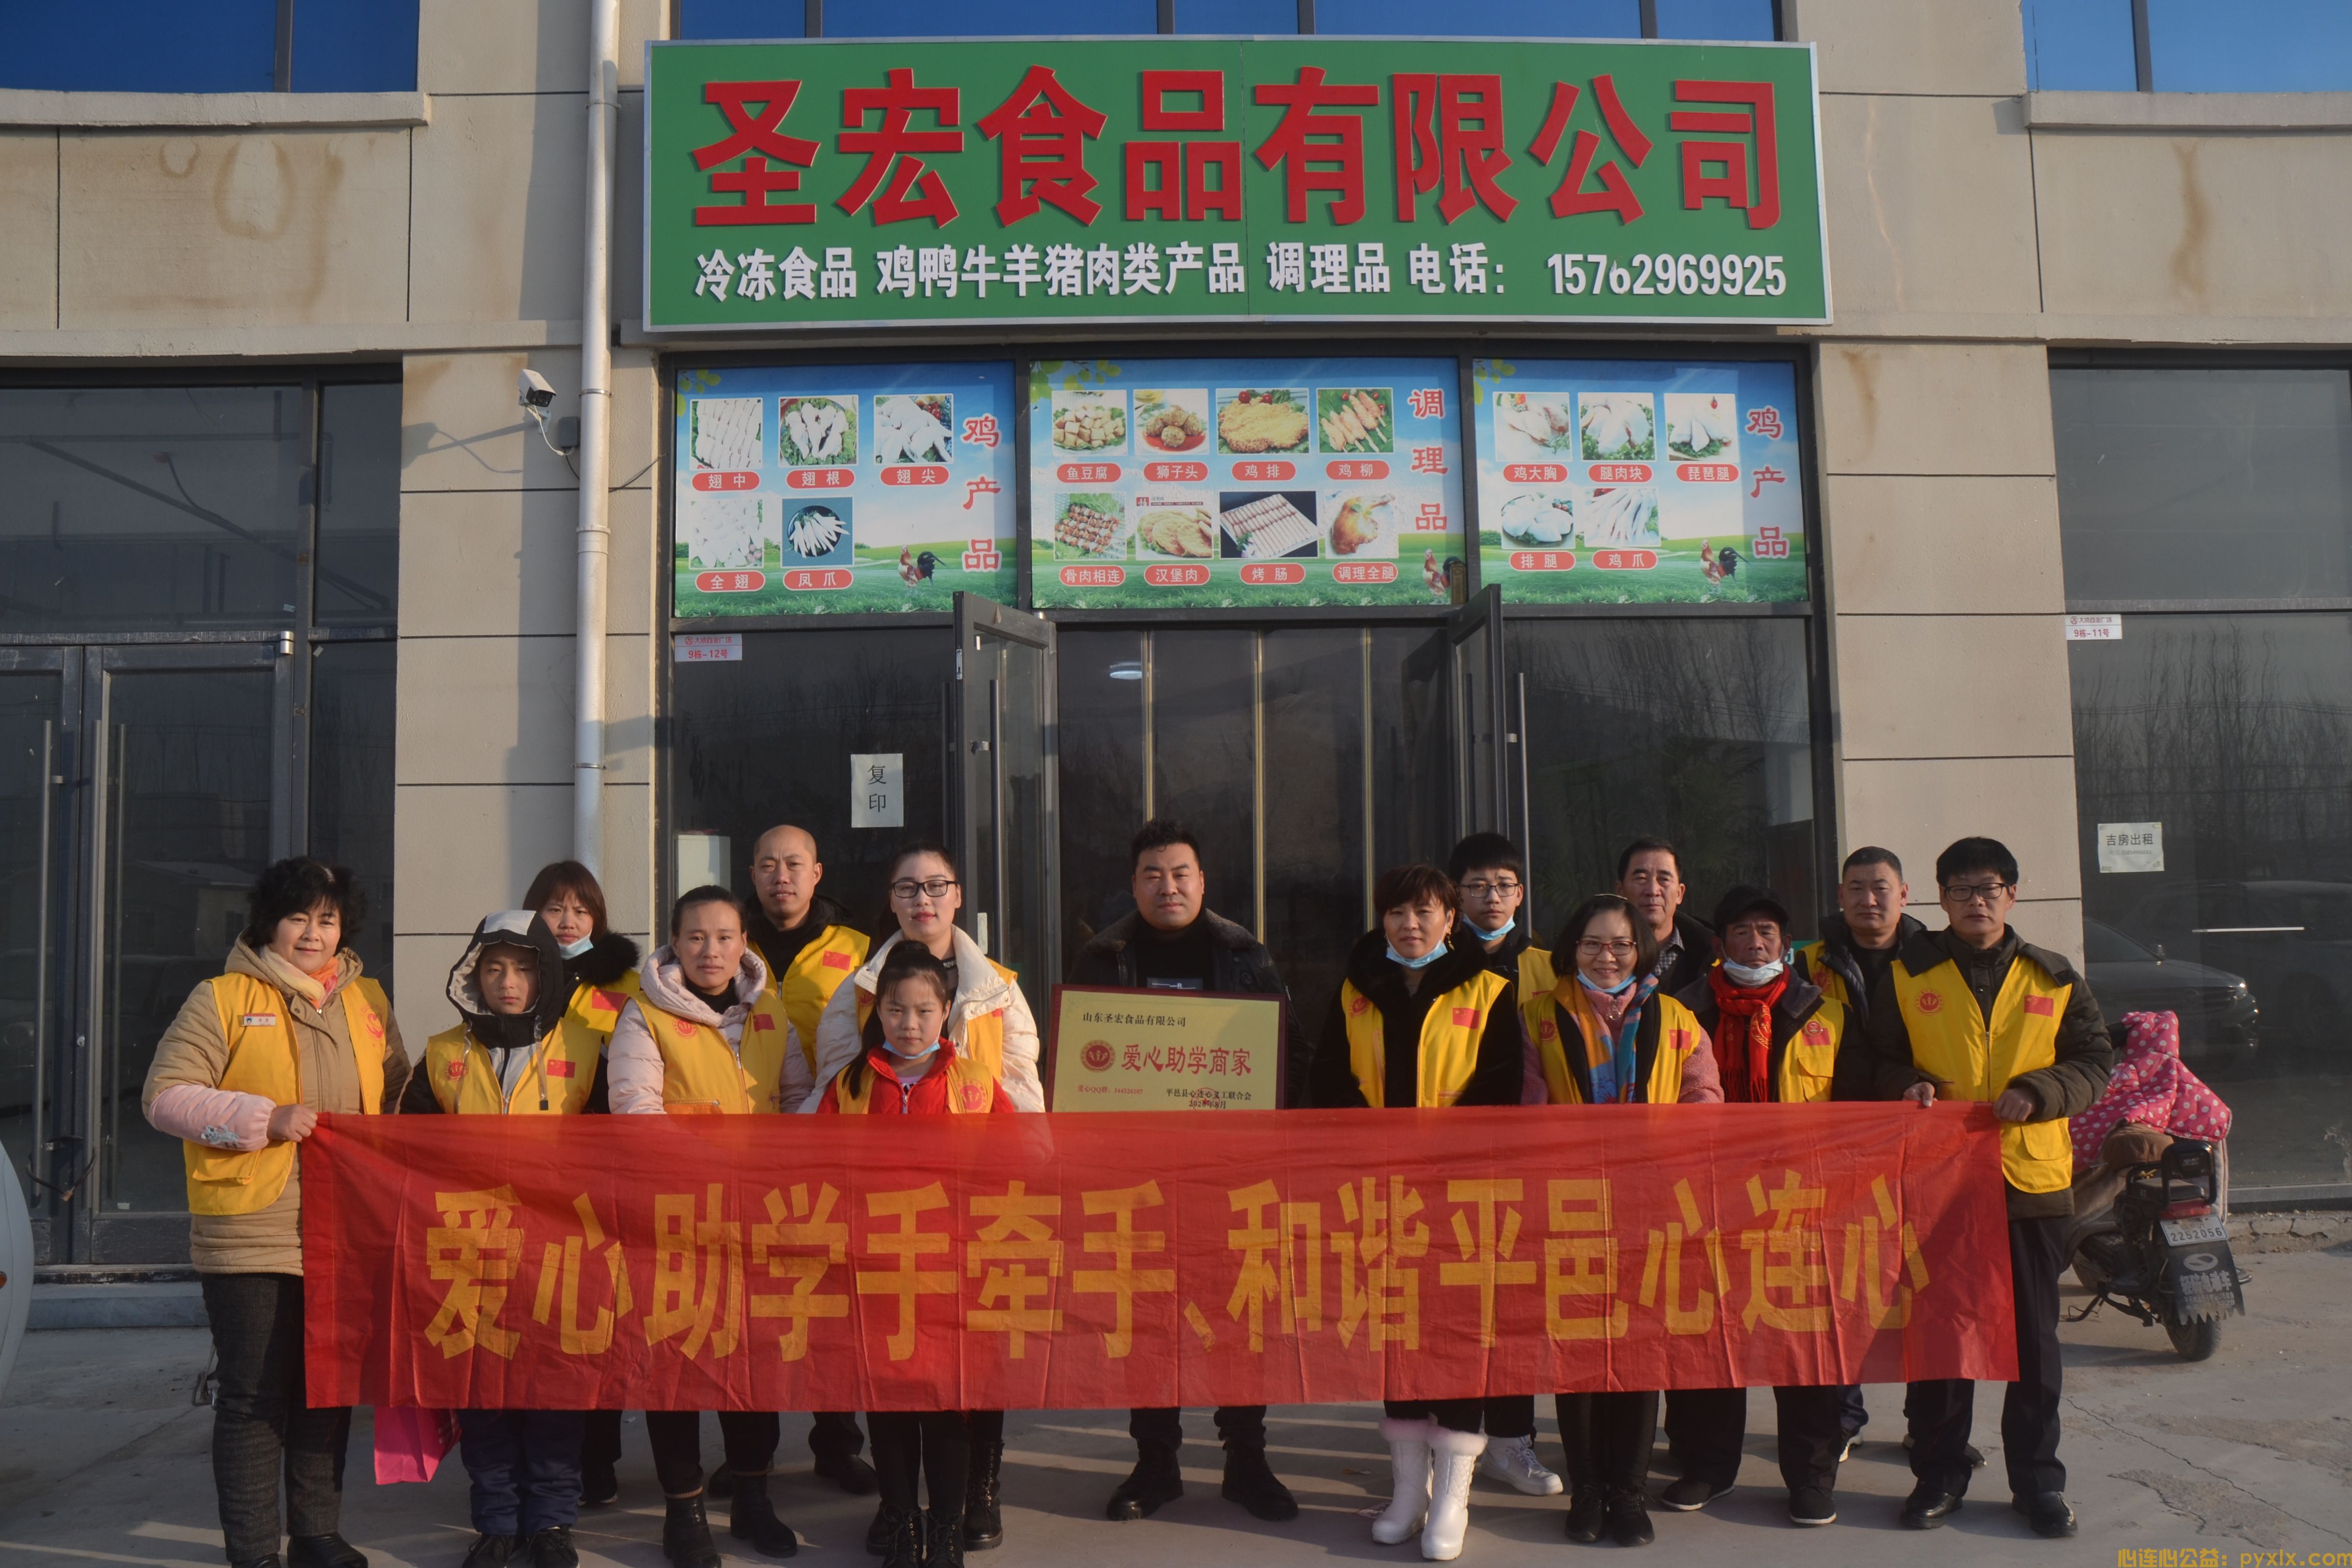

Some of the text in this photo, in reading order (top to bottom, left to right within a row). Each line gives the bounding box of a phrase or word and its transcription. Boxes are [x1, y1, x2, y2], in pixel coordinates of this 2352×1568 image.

[690, 64, 1780, 230] 圣宏食品有限公司
[694, 245, 857, 302] 冷冻食品
[876, 241, 1245, 298] 鸡鸭牛羊猪肉类产品
[1266, 241, 1390, 293] 调理品
[1547, 253, 1786, 296] 15762969925
[1406, 388, 1450, 532] 调理品
[896, 468, 936, 484] 翅尖
[1066, 464, 1107, 481] 鱼豆腐
[1156, 464, 1198, 480] 狮子头
[1244, 464, 1280, 479] 鸡排
[1338, 462, 1374, 477] 鸡柳
[1514, 465, 1557, 481] 鸡大胸
[1600, 465, 1643, 481] 腿肉块
[1687, 465, 1730, 481] 琵琶腿
[708, 474, 746, 489] 翅中
[801, 471, 840, 486] 翅根
[1746, 407, 1790, 557] 鸡产品
[961, 414, 1003, 572] 鸡产品
[1521, 553, 1558, 569] 排腿
[1608, 553, 1644, 568] 鸡爪
[798, 572, 836, 587] 凤爪
[1065, 568, 1120, 583] 骨肉相连
[1156, 567, 1197, 582] 汉堡肉
[1252, 567, 1287, 581] 烤肠
[1338, 566, 1394, 580] 调理全腿
[710, 575, 749, 590] 全翅
[2074, 629, 2109, 638] 9栋-11号
[688, 649, 728, 659] 9栋-12号
[868, 765, 887, 813] 复印
[2106, 834, 2153, 846] 吉房出租
[1083, 1012, 1186, 1027] 山东圣宏食品有限公司
[1121, 1044, 1252, 1076] 爱心助学商家
[1166, 1088, 1252, 1100] 平邑县心连心义工联合会
[2171, 1228, 2222, 1241] 2252056
[424, 1174, 1929, 1363] 爱心助学手牵手、和谐平邑心连心
